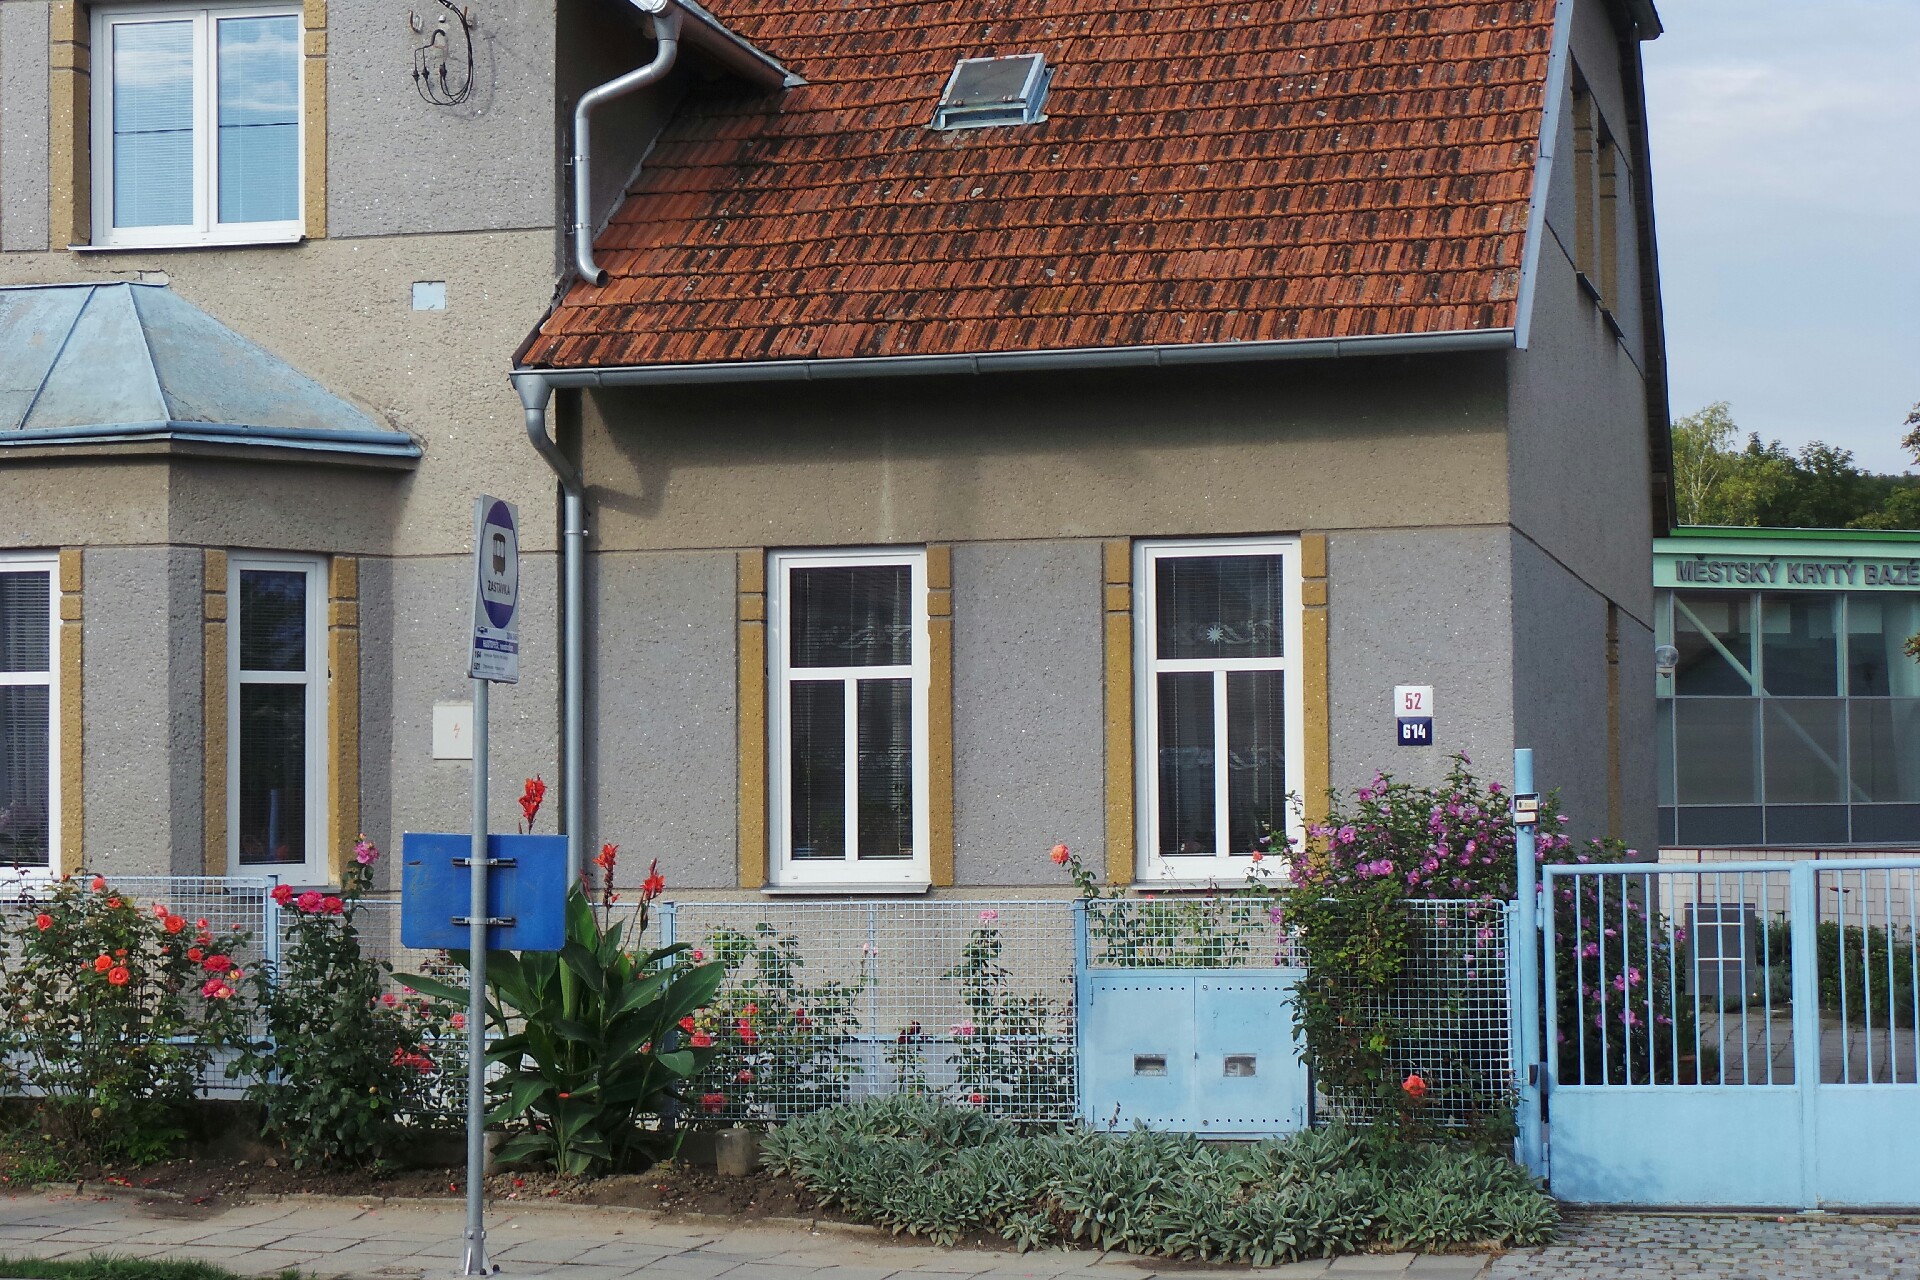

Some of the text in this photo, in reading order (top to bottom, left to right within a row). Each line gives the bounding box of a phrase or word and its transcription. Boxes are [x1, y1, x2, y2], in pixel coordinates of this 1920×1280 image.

[1675, 554, 1779, 584] MĚSTSKÝ
[1786, 558, 1857, 585] KRYTÝ
[1405, 692, 1422, 710] 52
[1402, 723, 1426, 739] 614
